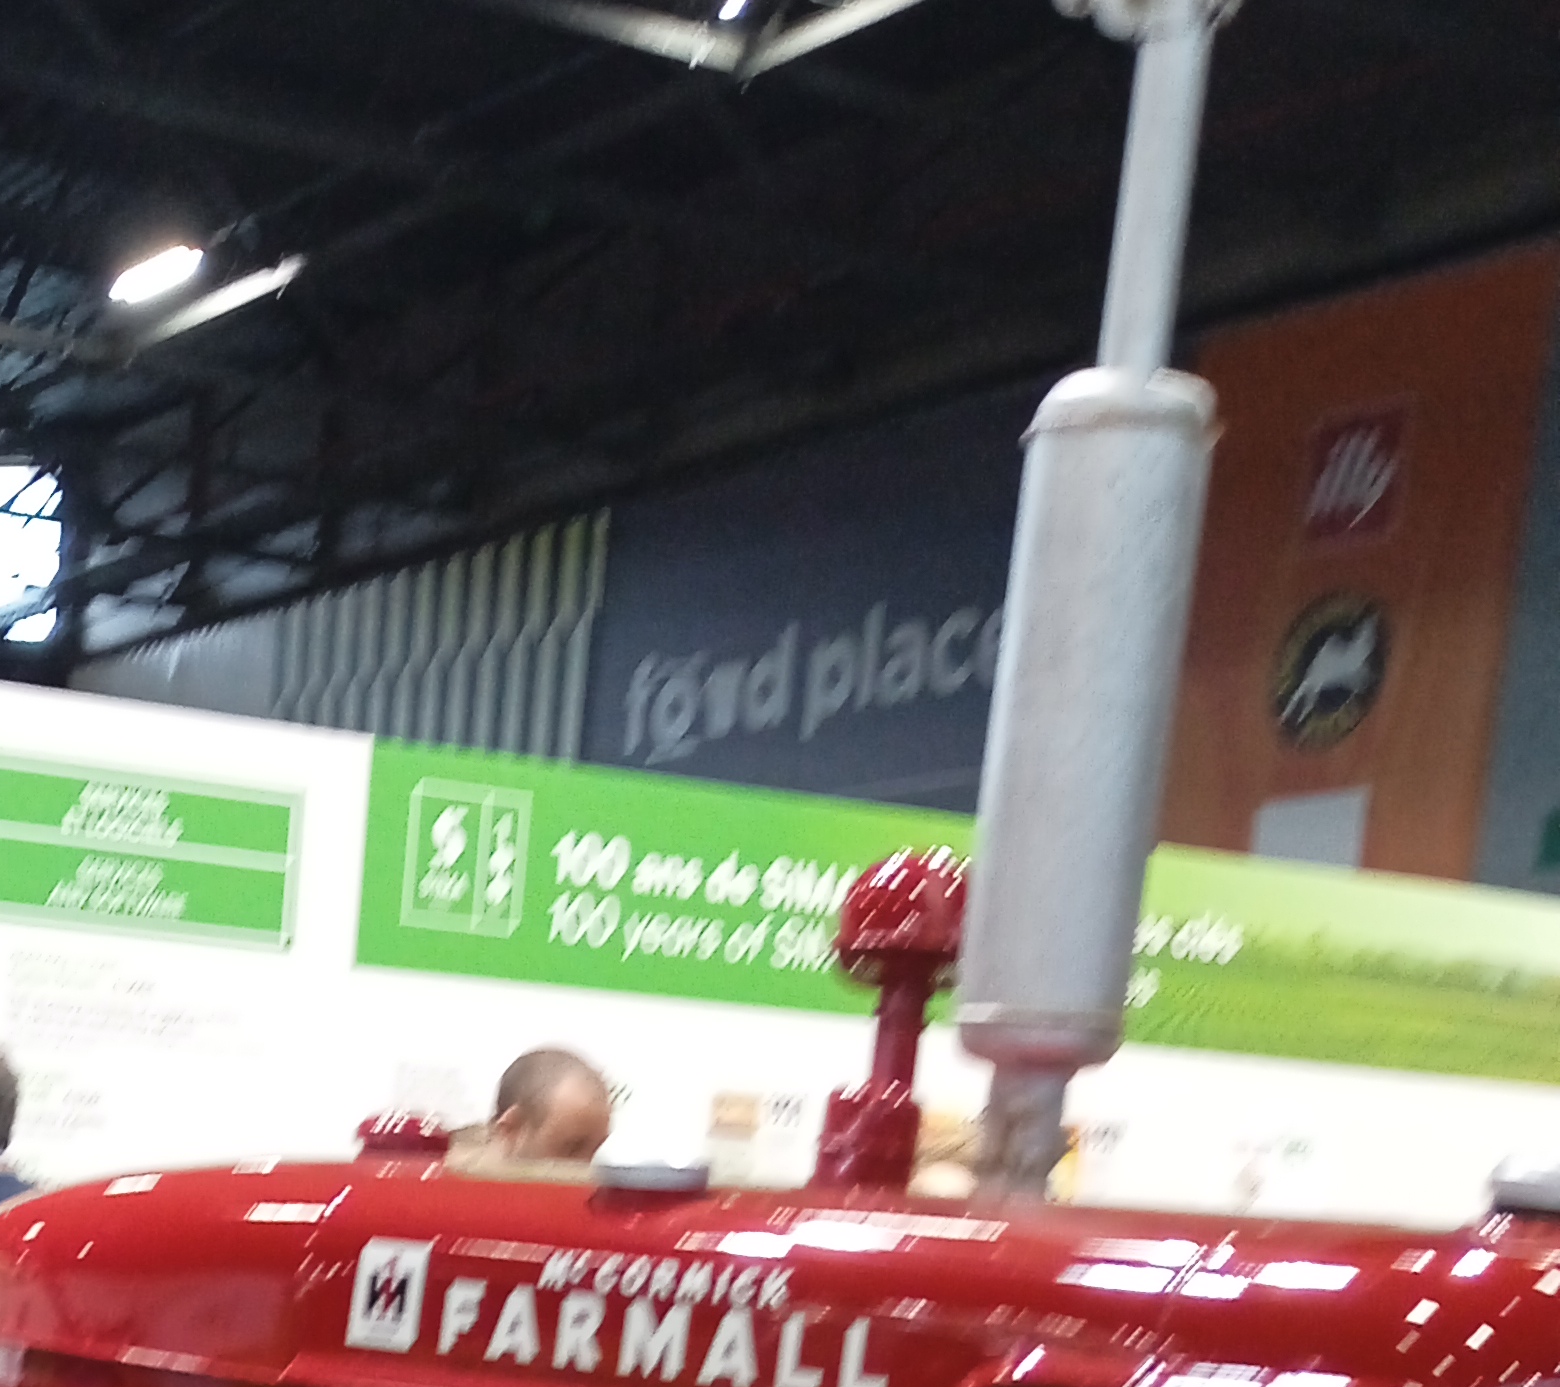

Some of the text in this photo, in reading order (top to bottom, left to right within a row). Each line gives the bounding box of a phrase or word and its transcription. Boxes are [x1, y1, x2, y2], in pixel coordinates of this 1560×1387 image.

[550, 829, 631, 891] 100
[547, 891, 621, 948] 100
[620, 911, 725, 962] years
